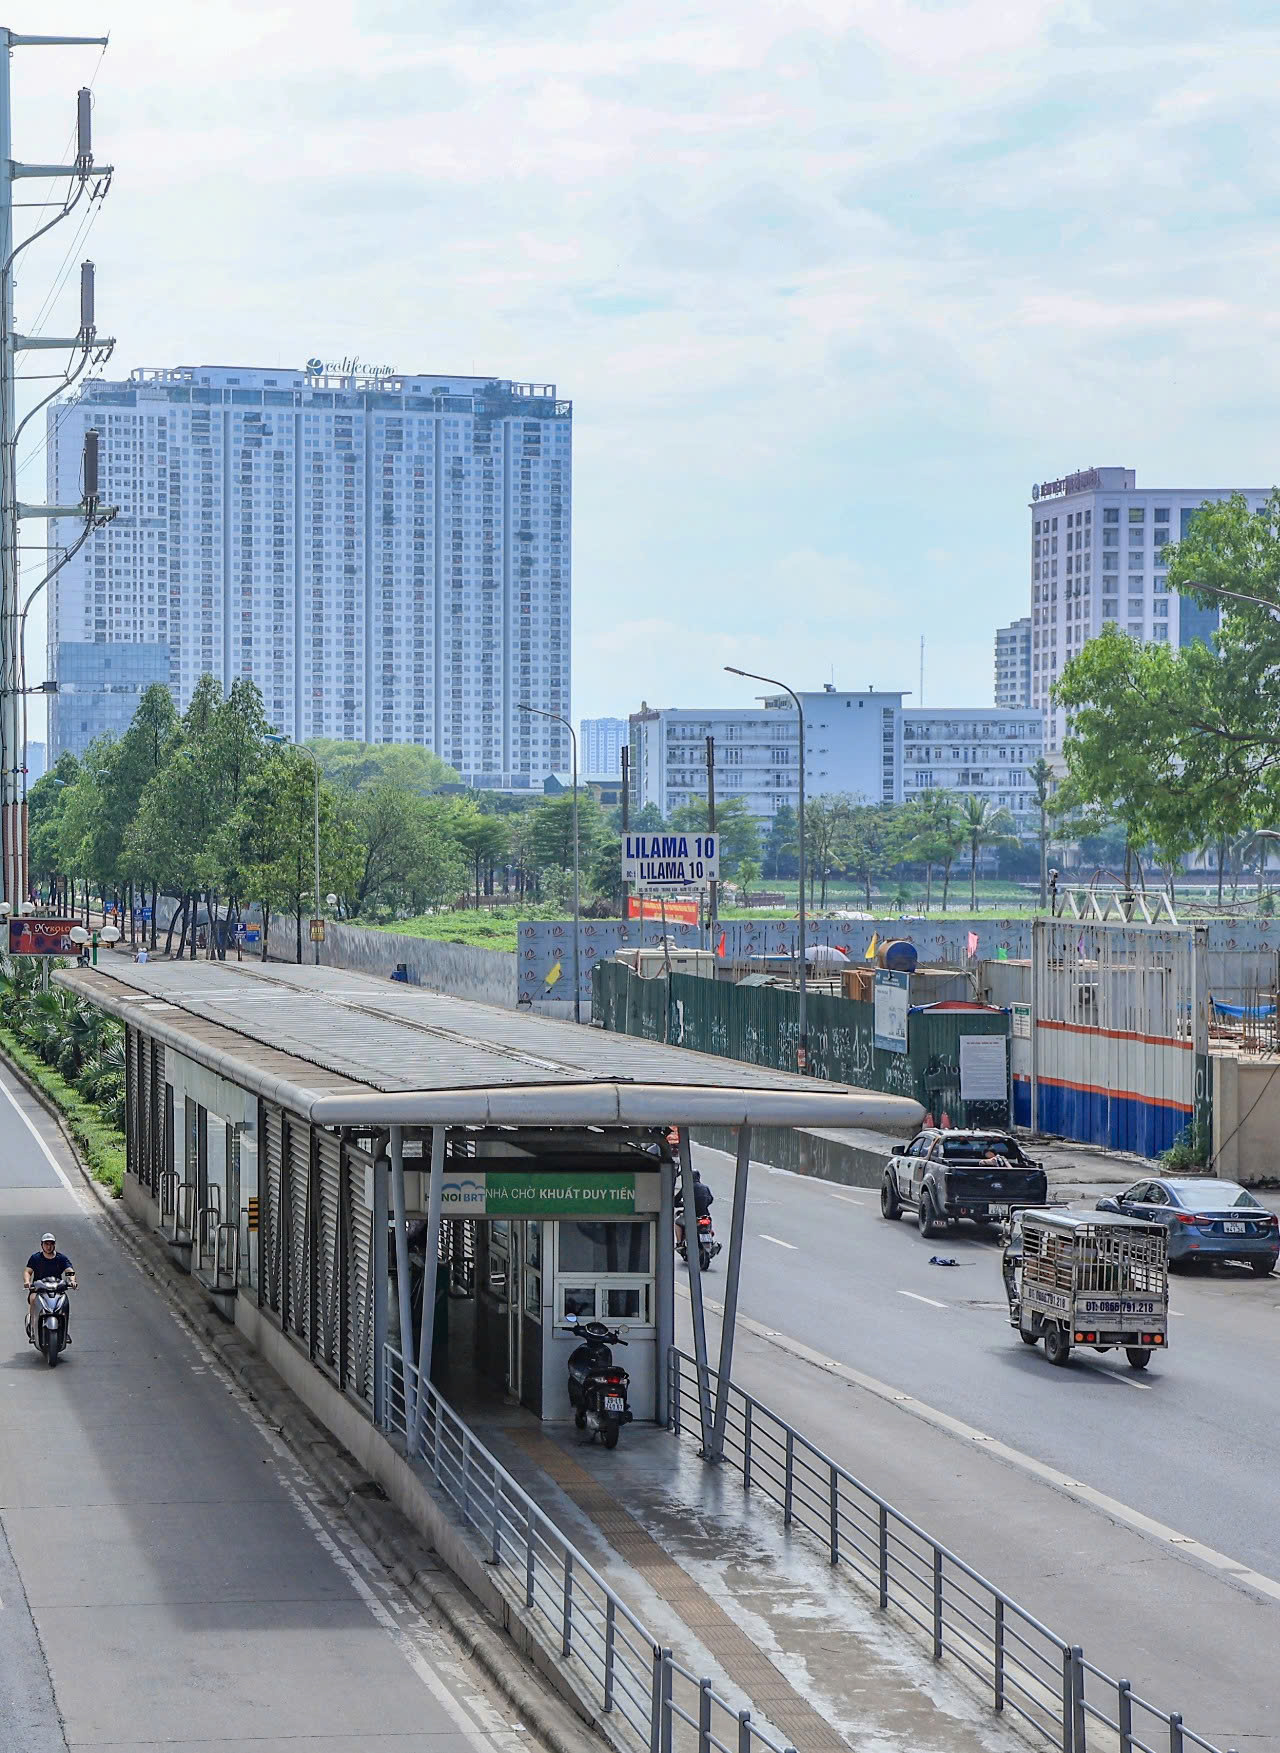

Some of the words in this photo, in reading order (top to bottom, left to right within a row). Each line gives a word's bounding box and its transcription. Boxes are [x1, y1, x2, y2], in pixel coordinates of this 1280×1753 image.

[626, 837, 689, 859] LILAMA
[695, 837, 714, 859] 10
[640, 861, 685, 879] LILAMA
[689, 861, 704, 879] 10
[34, 923, 71, 935] MYKOLO
[424, 1192, 461, 1202] HNOI
[463, 1193, 485, 1202] BRT
[485, 1186, 509, 1199] NHÀ
[511, 1187, 537, 1199] CHỜ
[539, 1186, 581, 1200] KHUẤT
[582, 1190, 607, 1200] DUY
[609, 1186, 635, 1200] TIẾN
